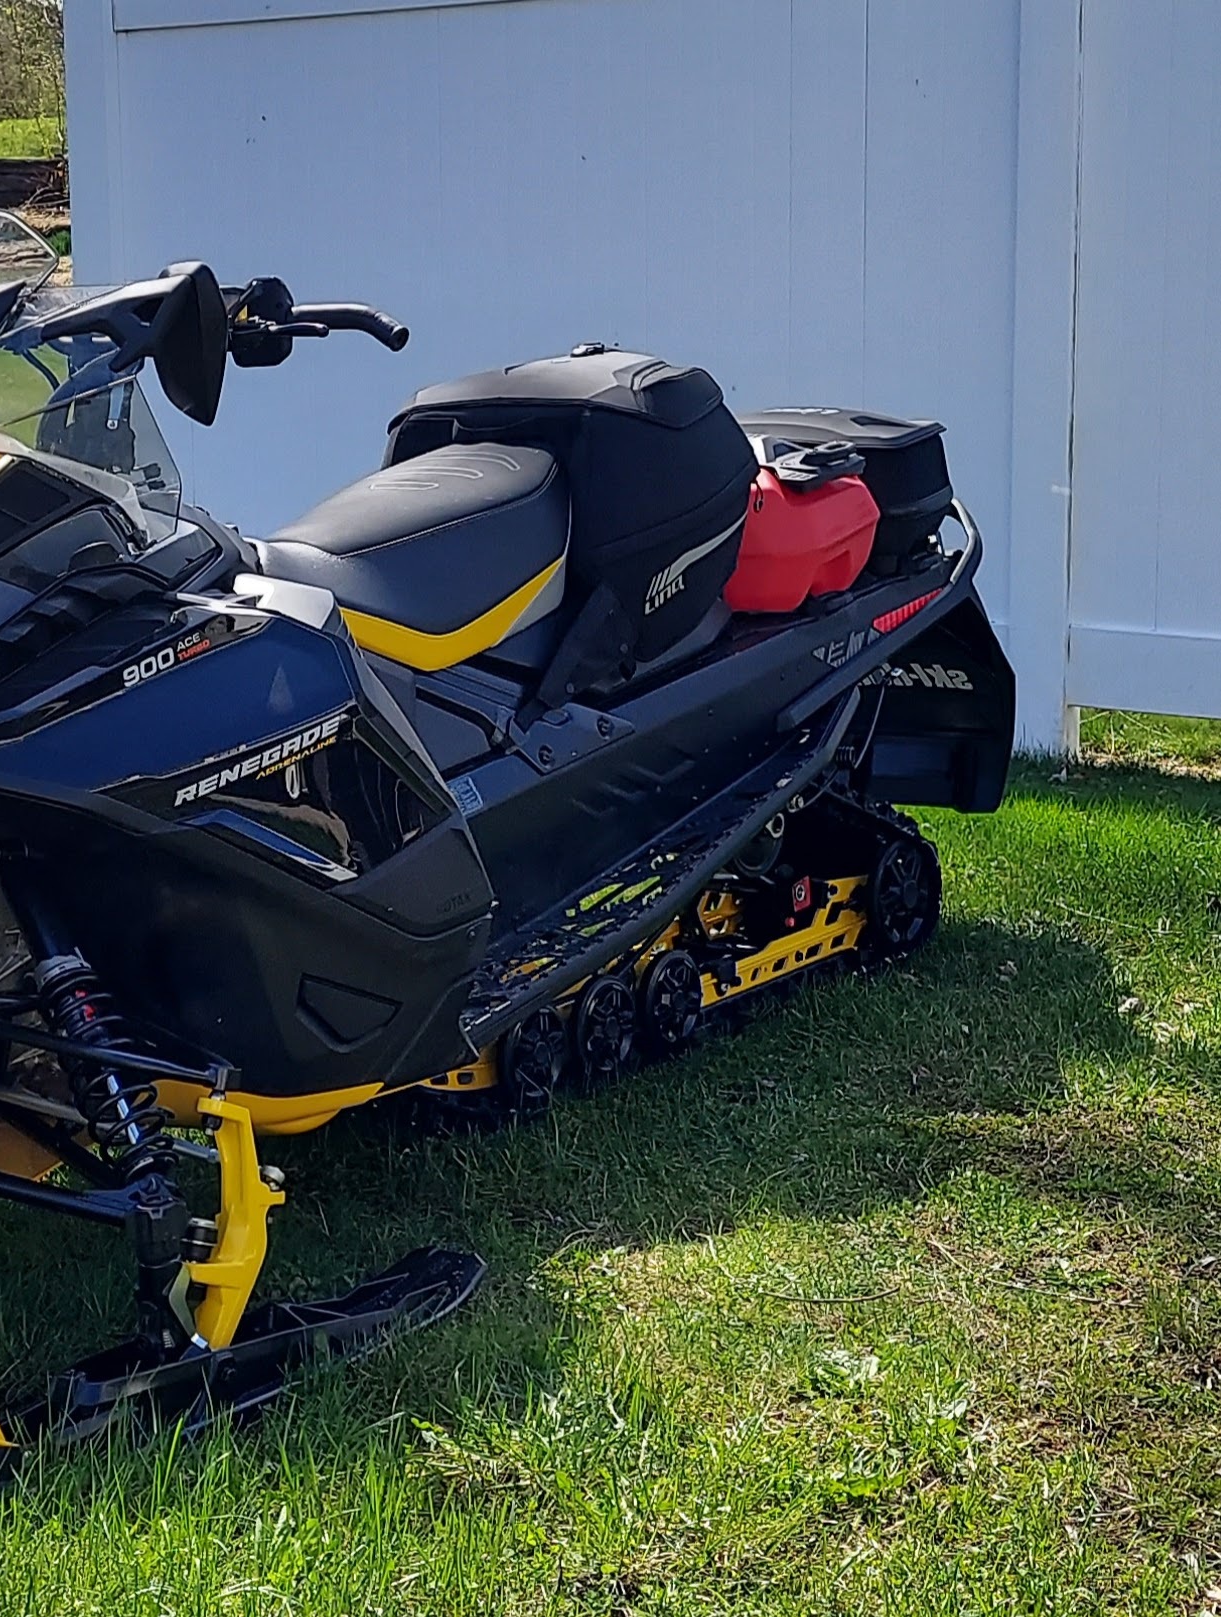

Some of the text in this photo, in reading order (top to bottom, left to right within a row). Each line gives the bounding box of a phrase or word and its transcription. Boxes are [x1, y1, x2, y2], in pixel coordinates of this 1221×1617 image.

[122, 632, 201, 688] 900 ACE
[177, 639, 211, 661] TURBO
[173, 715, 340, 808] RENEGADE
[255, 735, 337, 781] ADRENALINE
